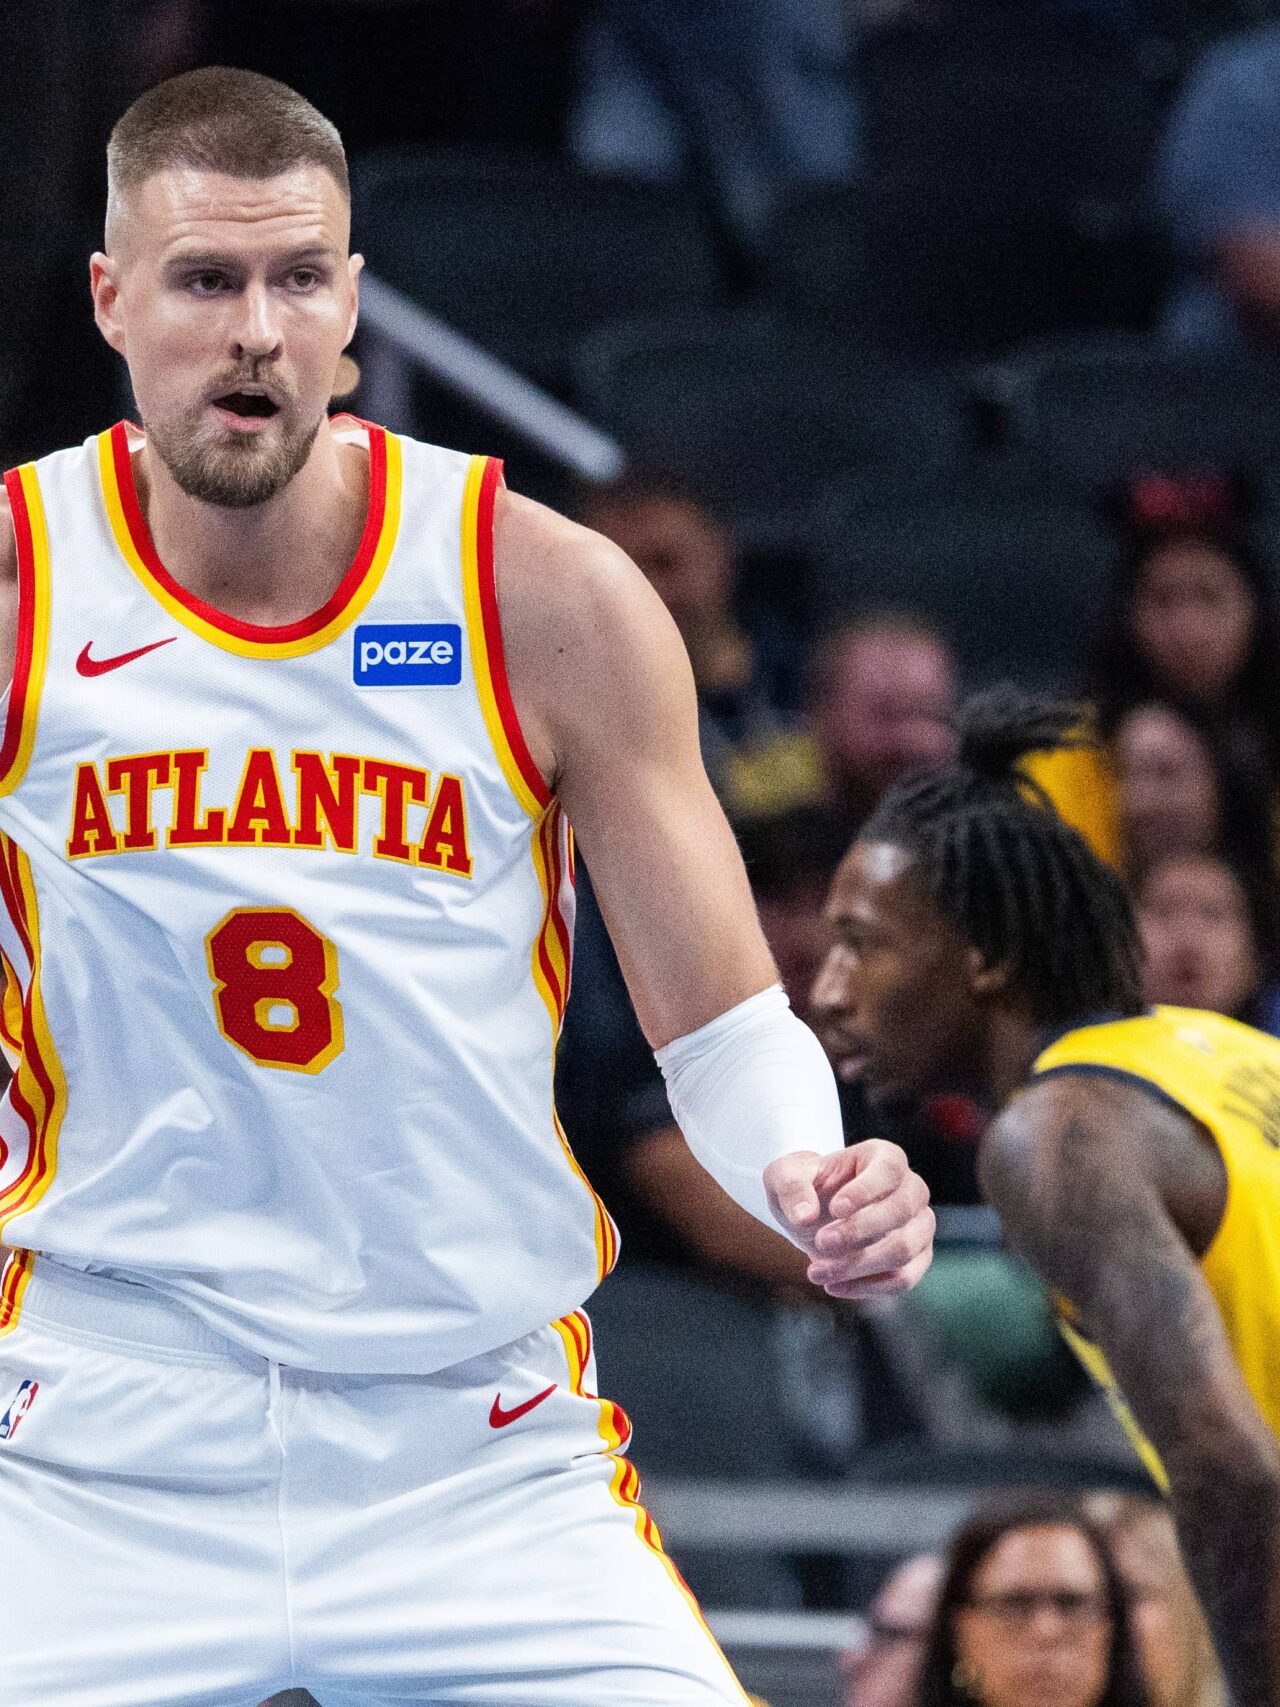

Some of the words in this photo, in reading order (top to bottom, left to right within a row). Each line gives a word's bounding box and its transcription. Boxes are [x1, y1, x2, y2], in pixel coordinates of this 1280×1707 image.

[360, 640, 454, 672] paze
[66, 746, 473, 879] ATLANTA
[204, 905, 346, 1076] 8
